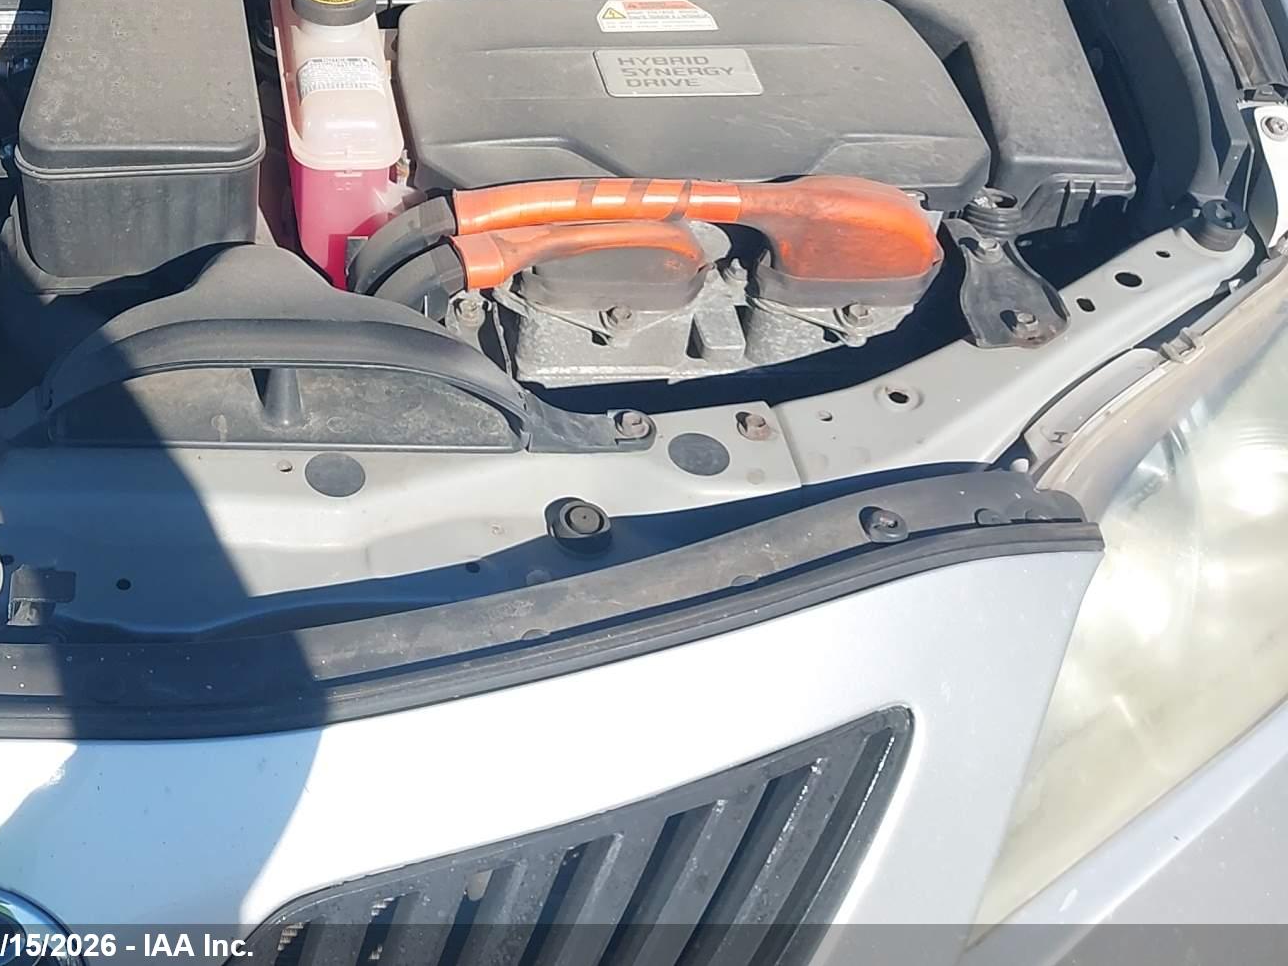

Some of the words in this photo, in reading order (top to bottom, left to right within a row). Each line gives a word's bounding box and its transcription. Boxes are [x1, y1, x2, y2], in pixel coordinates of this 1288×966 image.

[617, 56, 709, 66] HYBRID
[621, 66, 734, 77] SYNERGY
[625, 78, 702, 88] DRIVE
